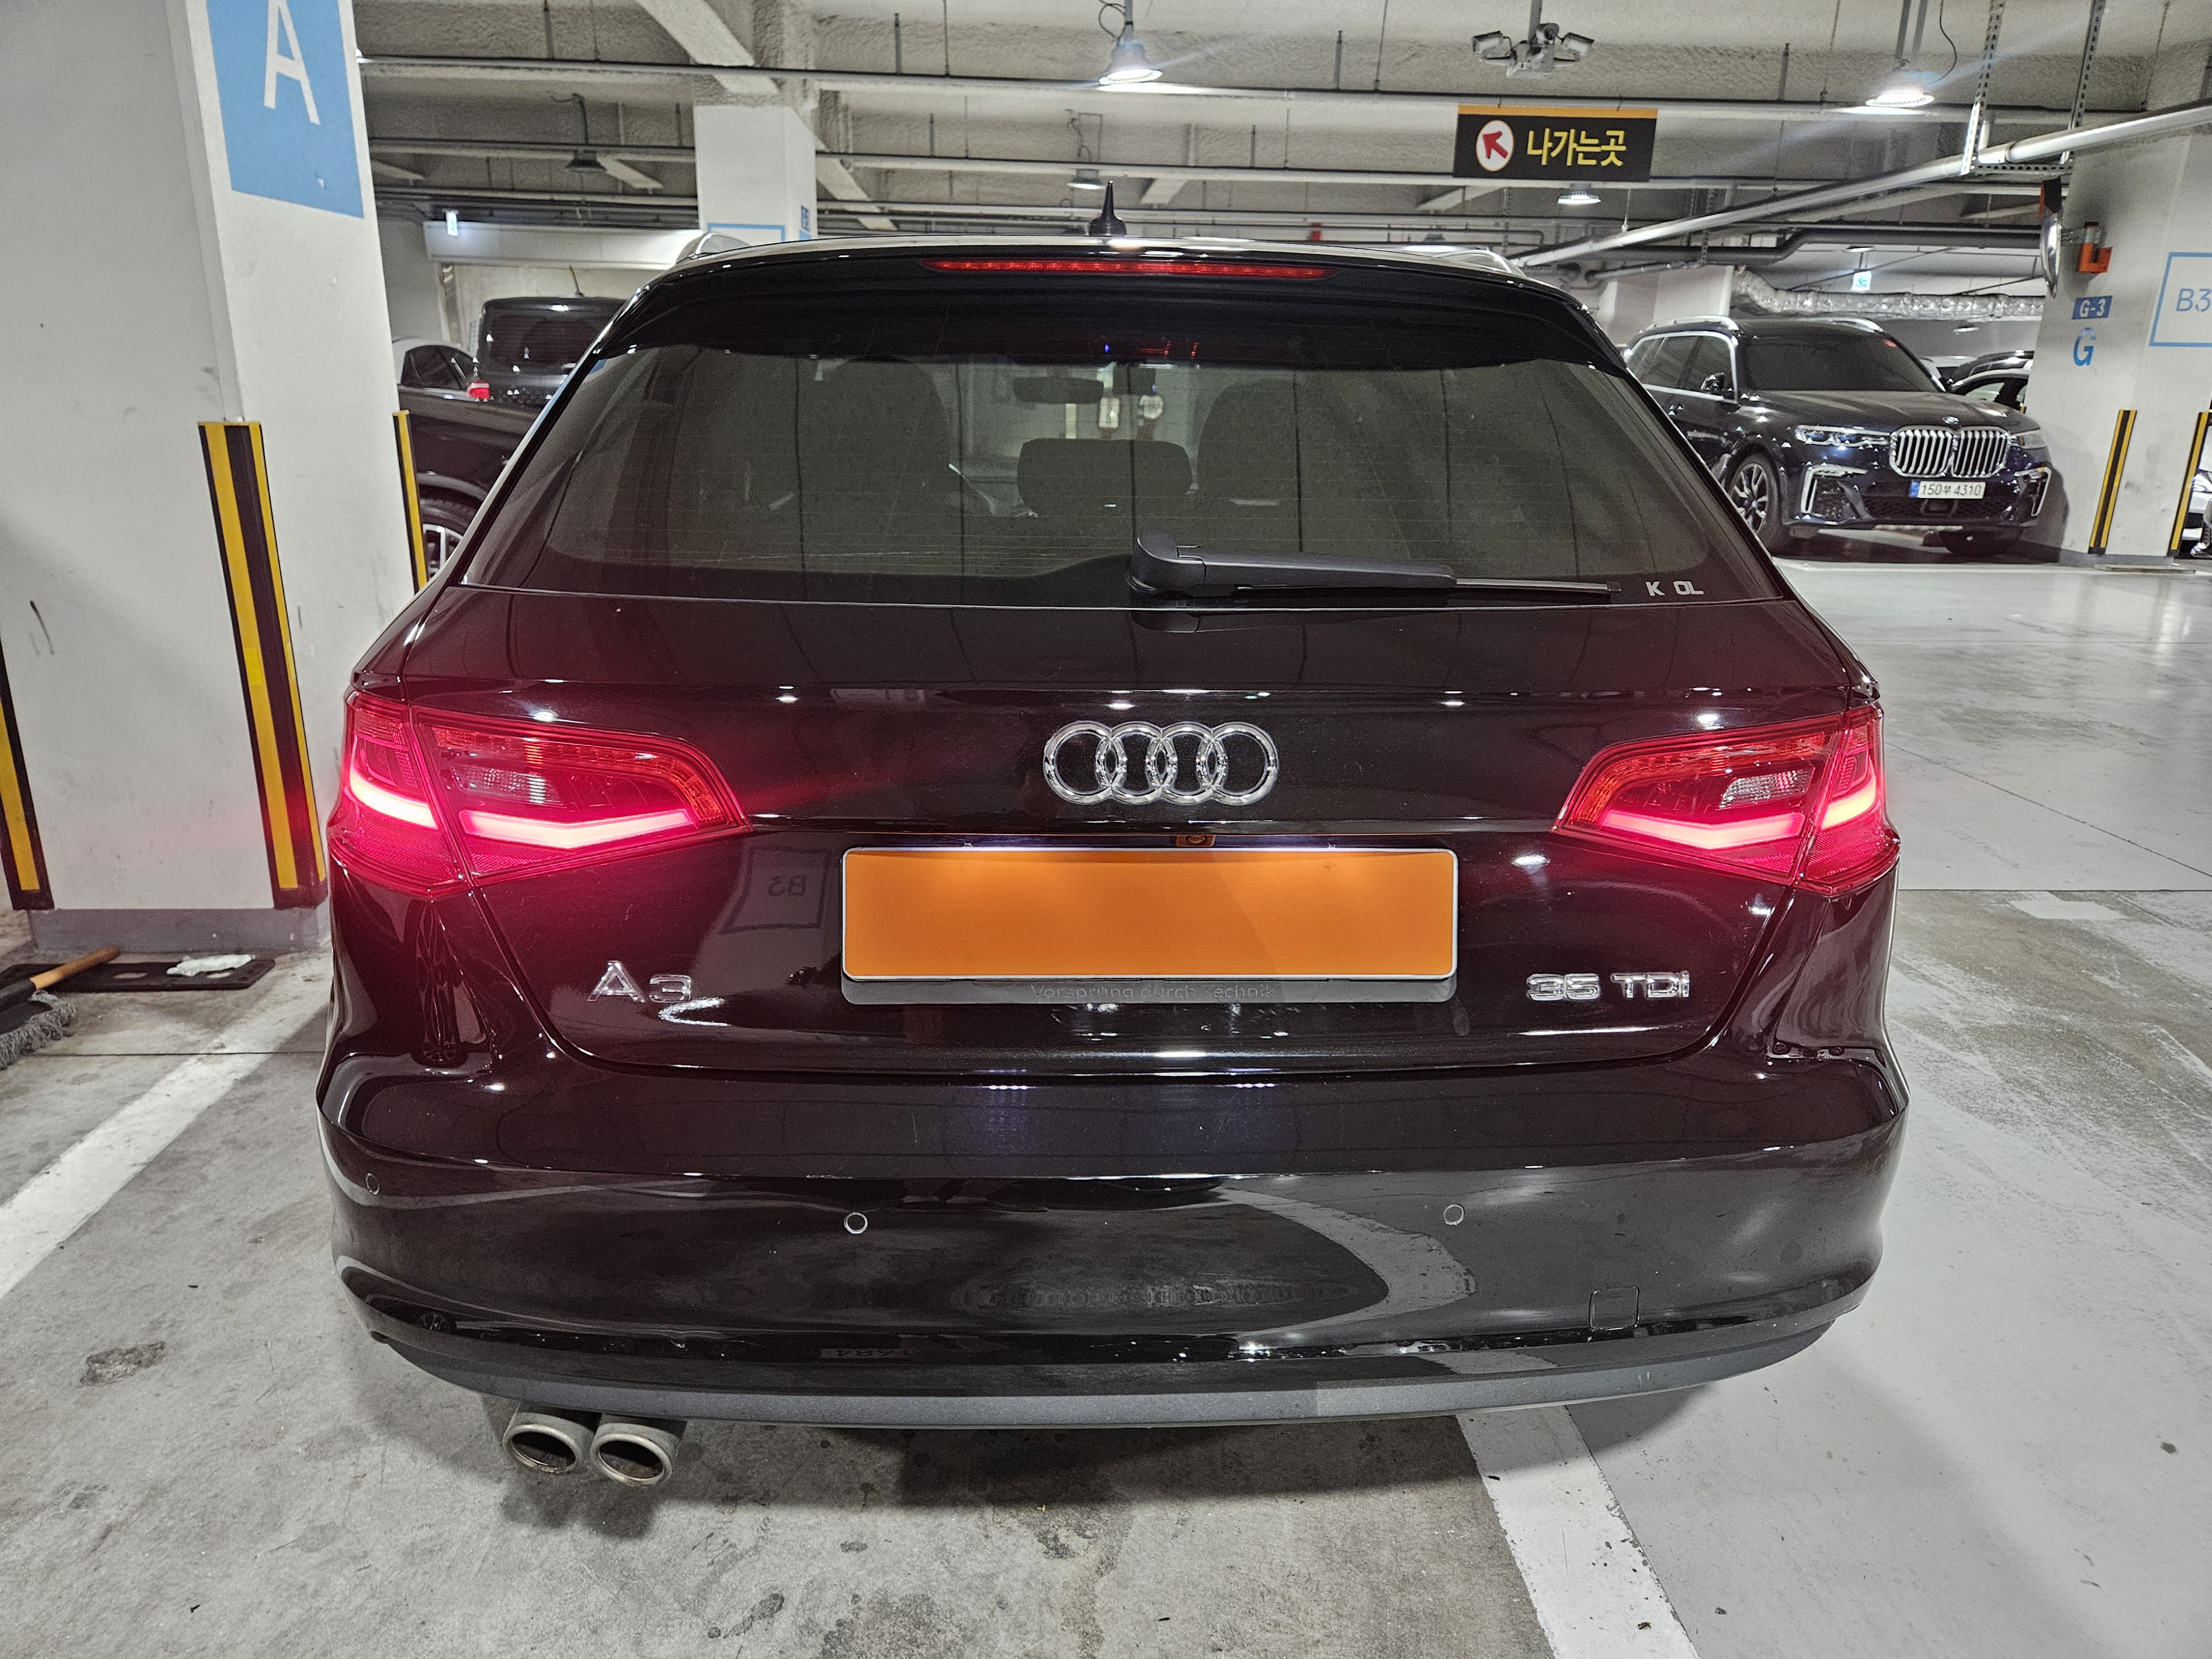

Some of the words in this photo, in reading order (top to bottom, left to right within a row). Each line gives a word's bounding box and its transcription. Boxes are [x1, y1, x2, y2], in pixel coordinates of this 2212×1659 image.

[264, 0, 321, 126] A
[1527, 128, 1627, 166] 나가는곳
[2079, 298, 2106, 318] G-3
[2176, 288, 2212, 312] B3
[2073, 327, 2096, 366] G
[1954, 484, 1981, 495] 4310
[1526, 973, 1601, 1001] 35
